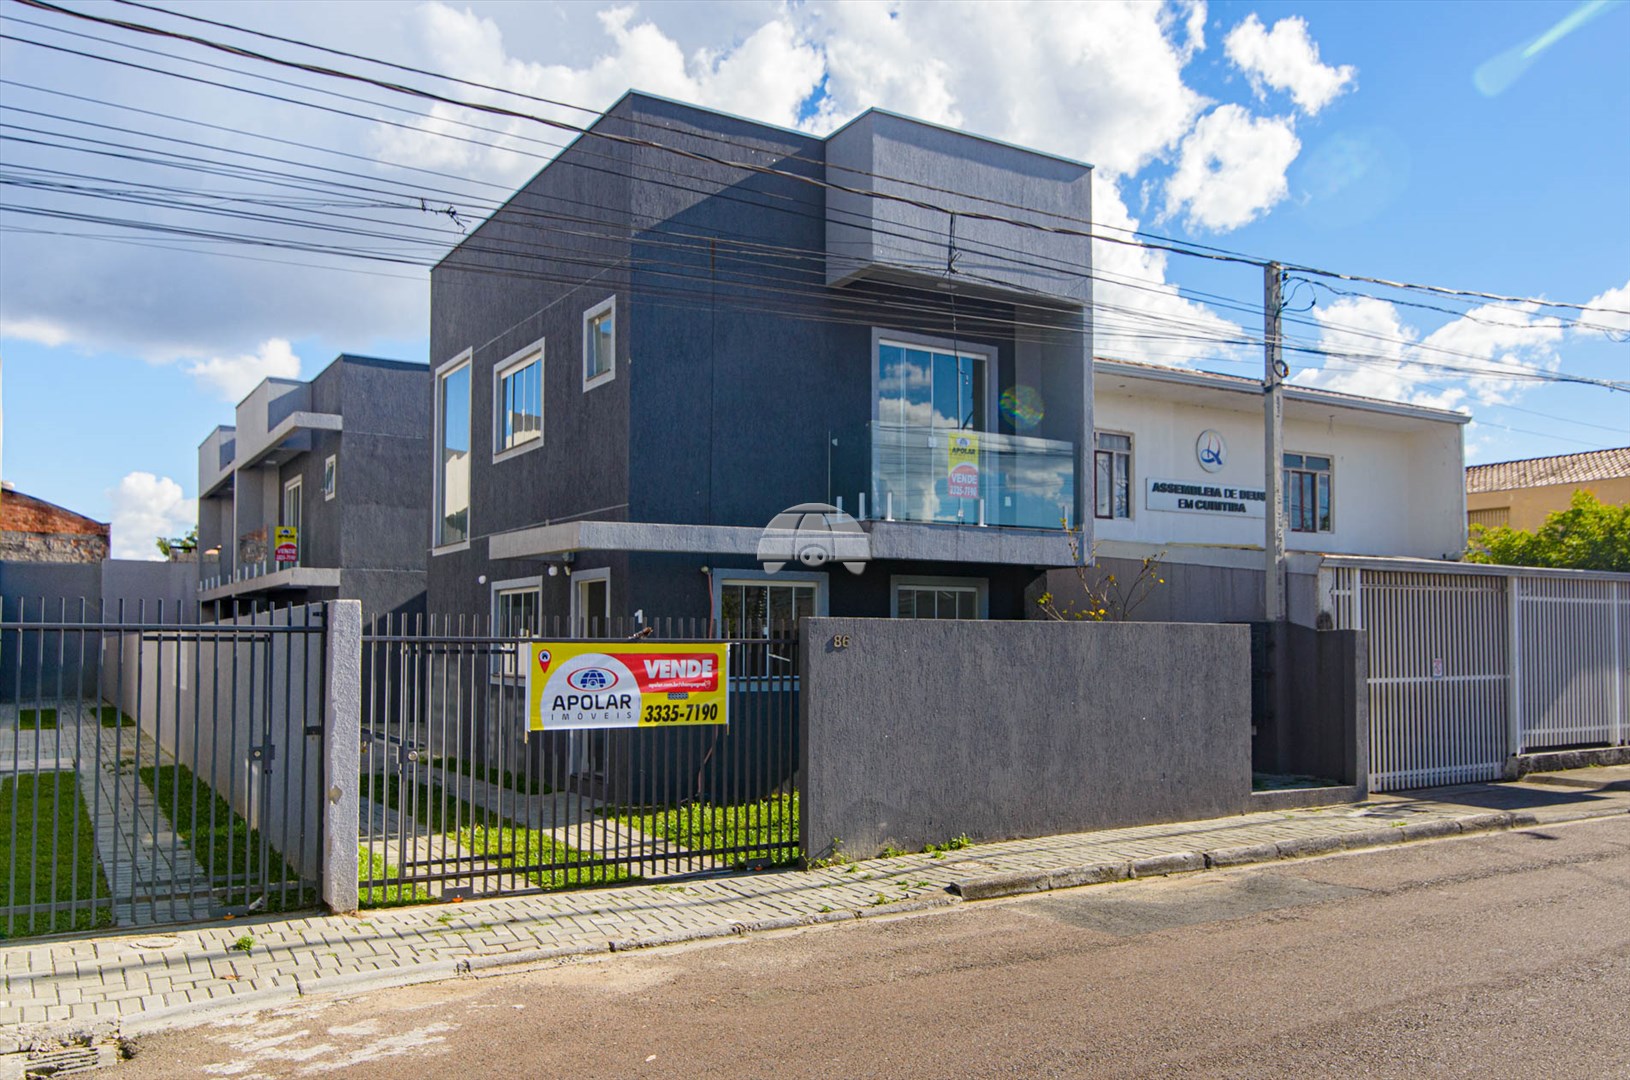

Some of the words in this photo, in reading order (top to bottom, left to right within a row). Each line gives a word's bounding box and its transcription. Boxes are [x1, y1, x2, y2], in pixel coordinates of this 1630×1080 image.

[952, 447, 976, 455] APOLAR
[951, 473, 977, 485] VENDE
[1152, 482, 1222, 498] ASSEMBLEIA
[1224, 488, 1237, 499] DE
[1178, 499, 1194, 510] EM
[1195, 501, 1246, 513] CURITIBA
[634, 609, 643, 624] 1
[833, 634, 850, 648] 86
[643, 659, 713, 679] VENDE
[552, 694, 632, 711] APOLAR
[644, 703, 718, 722] 3335-7190
